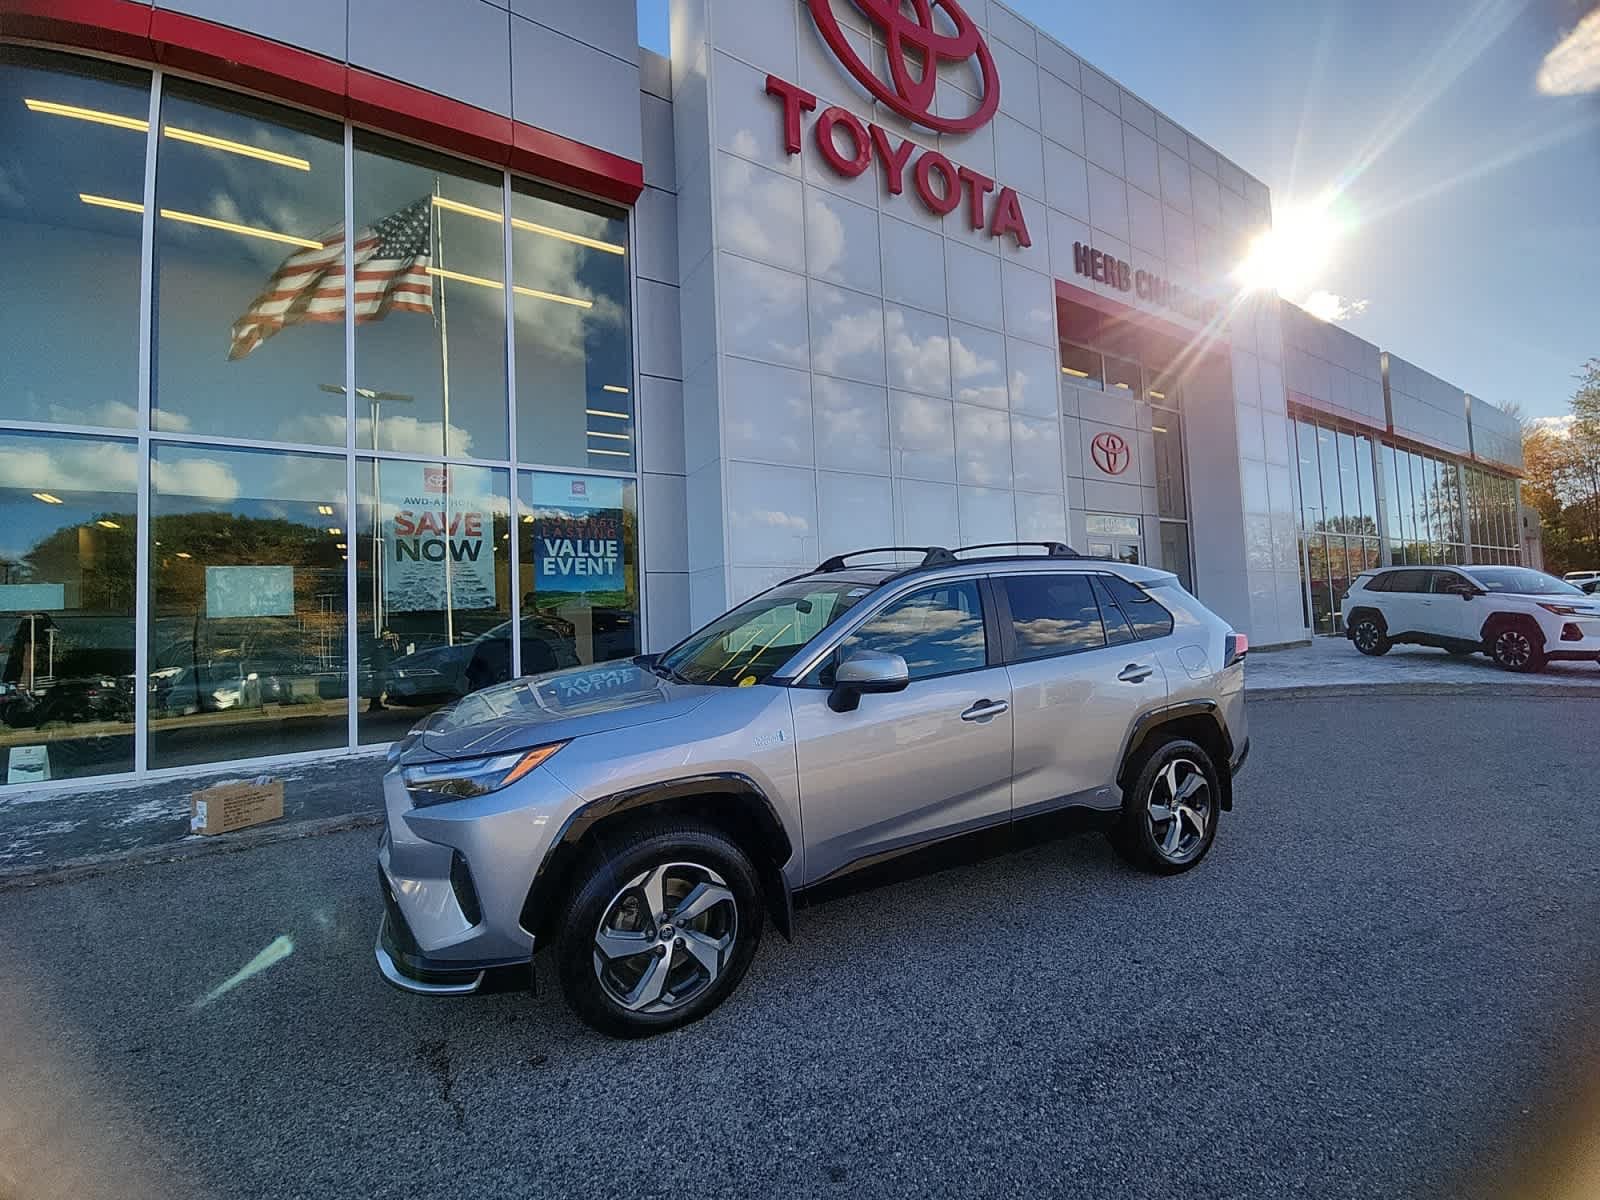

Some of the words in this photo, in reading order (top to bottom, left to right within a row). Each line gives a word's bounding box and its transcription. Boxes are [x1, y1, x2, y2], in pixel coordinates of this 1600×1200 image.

[765, 73, 1031, 248] TOYOTA
[1073, 240, 1132, 292] HERB
[395, 510, 482, 537] SAVE
[395, 538, 483, 562] NOW
[543, 538, 619, 558] VALUE
[543, 557, 618, 576] EVENT
